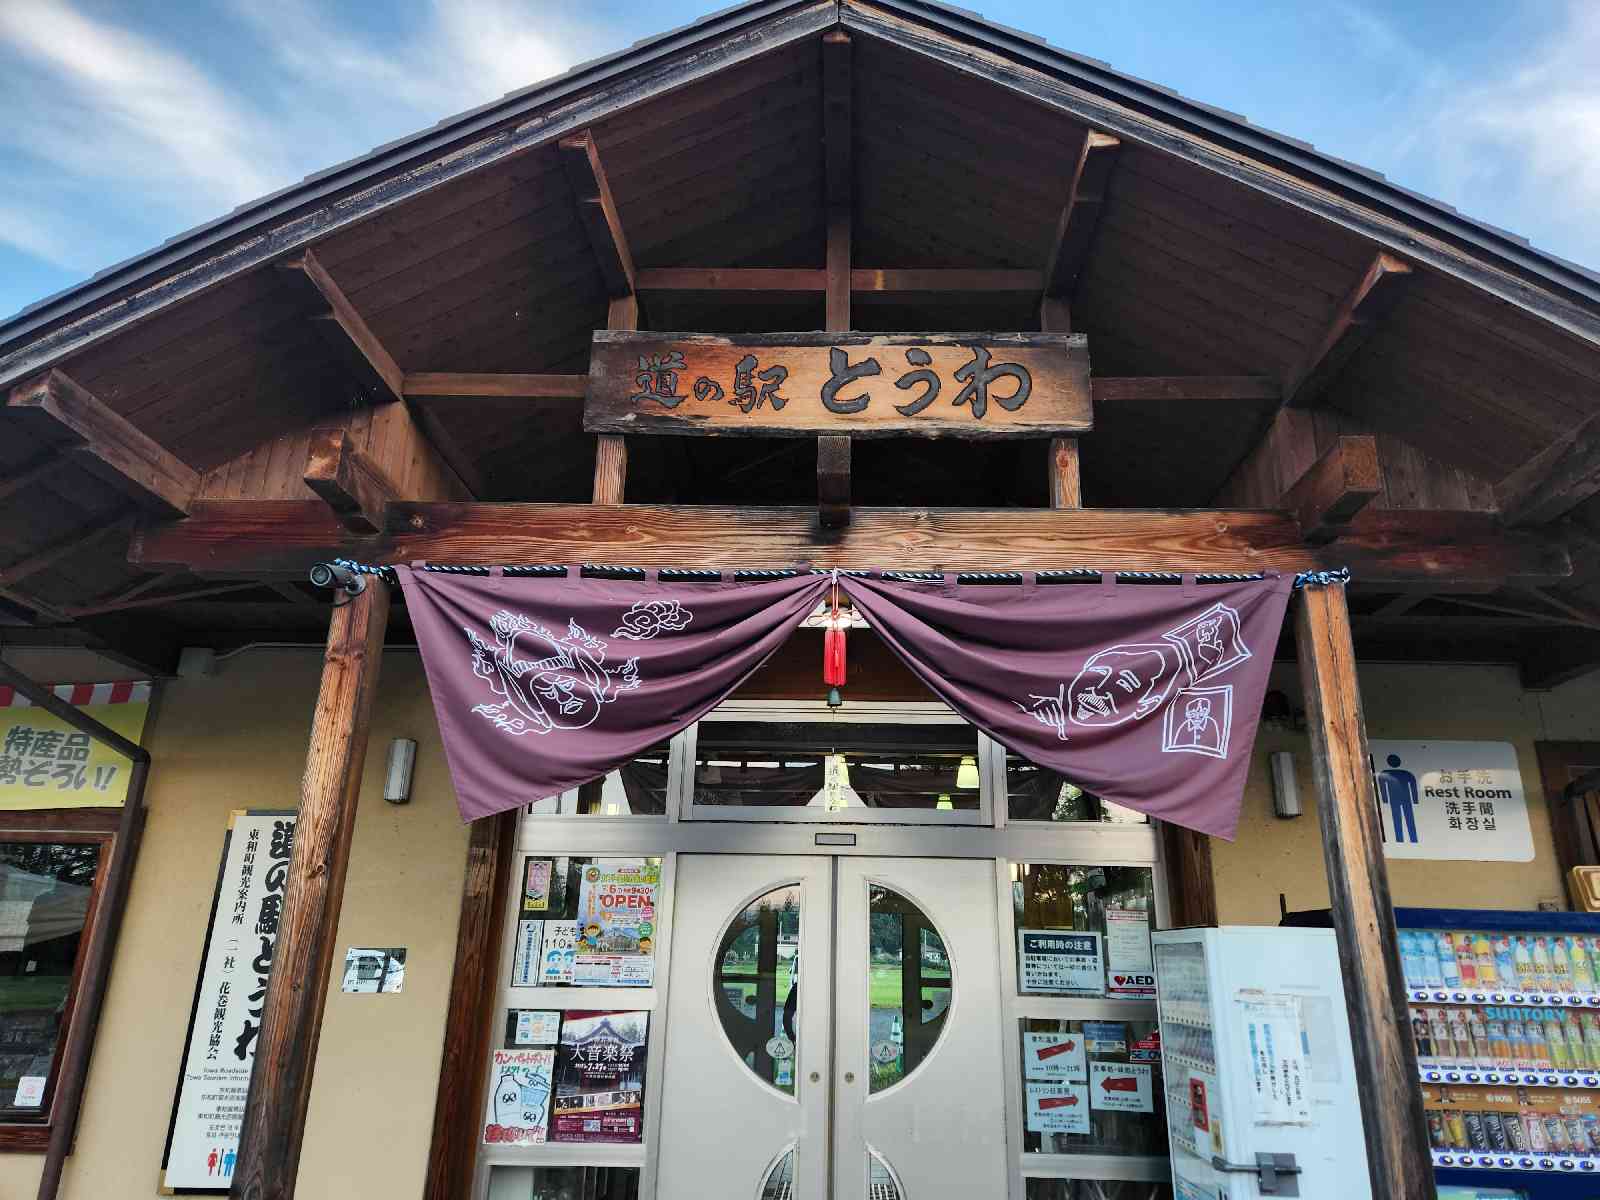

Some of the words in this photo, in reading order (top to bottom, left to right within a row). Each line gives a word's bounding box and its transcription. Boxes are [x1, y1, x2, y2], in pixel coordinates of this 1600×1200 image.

[631, 350, 790, 412] 道の駅
[819, 345, 1034, 420] とうわ
[4, 726, 90, 762] 特産品
[1424, 786, 1460, 799] Rest
[1464, 787, 1513, 800] Room
[1446, 801, 1495, 816] 洗手間
[1448, 817, 1497, 831] 화장실
[232, 828, 260, 926] 東和町観光案内所
[601, 895, 651, 908] OPEN
[1126, 975, 1155, 985] AED
[569, 1043, 635, 1062] 大音楽祭
